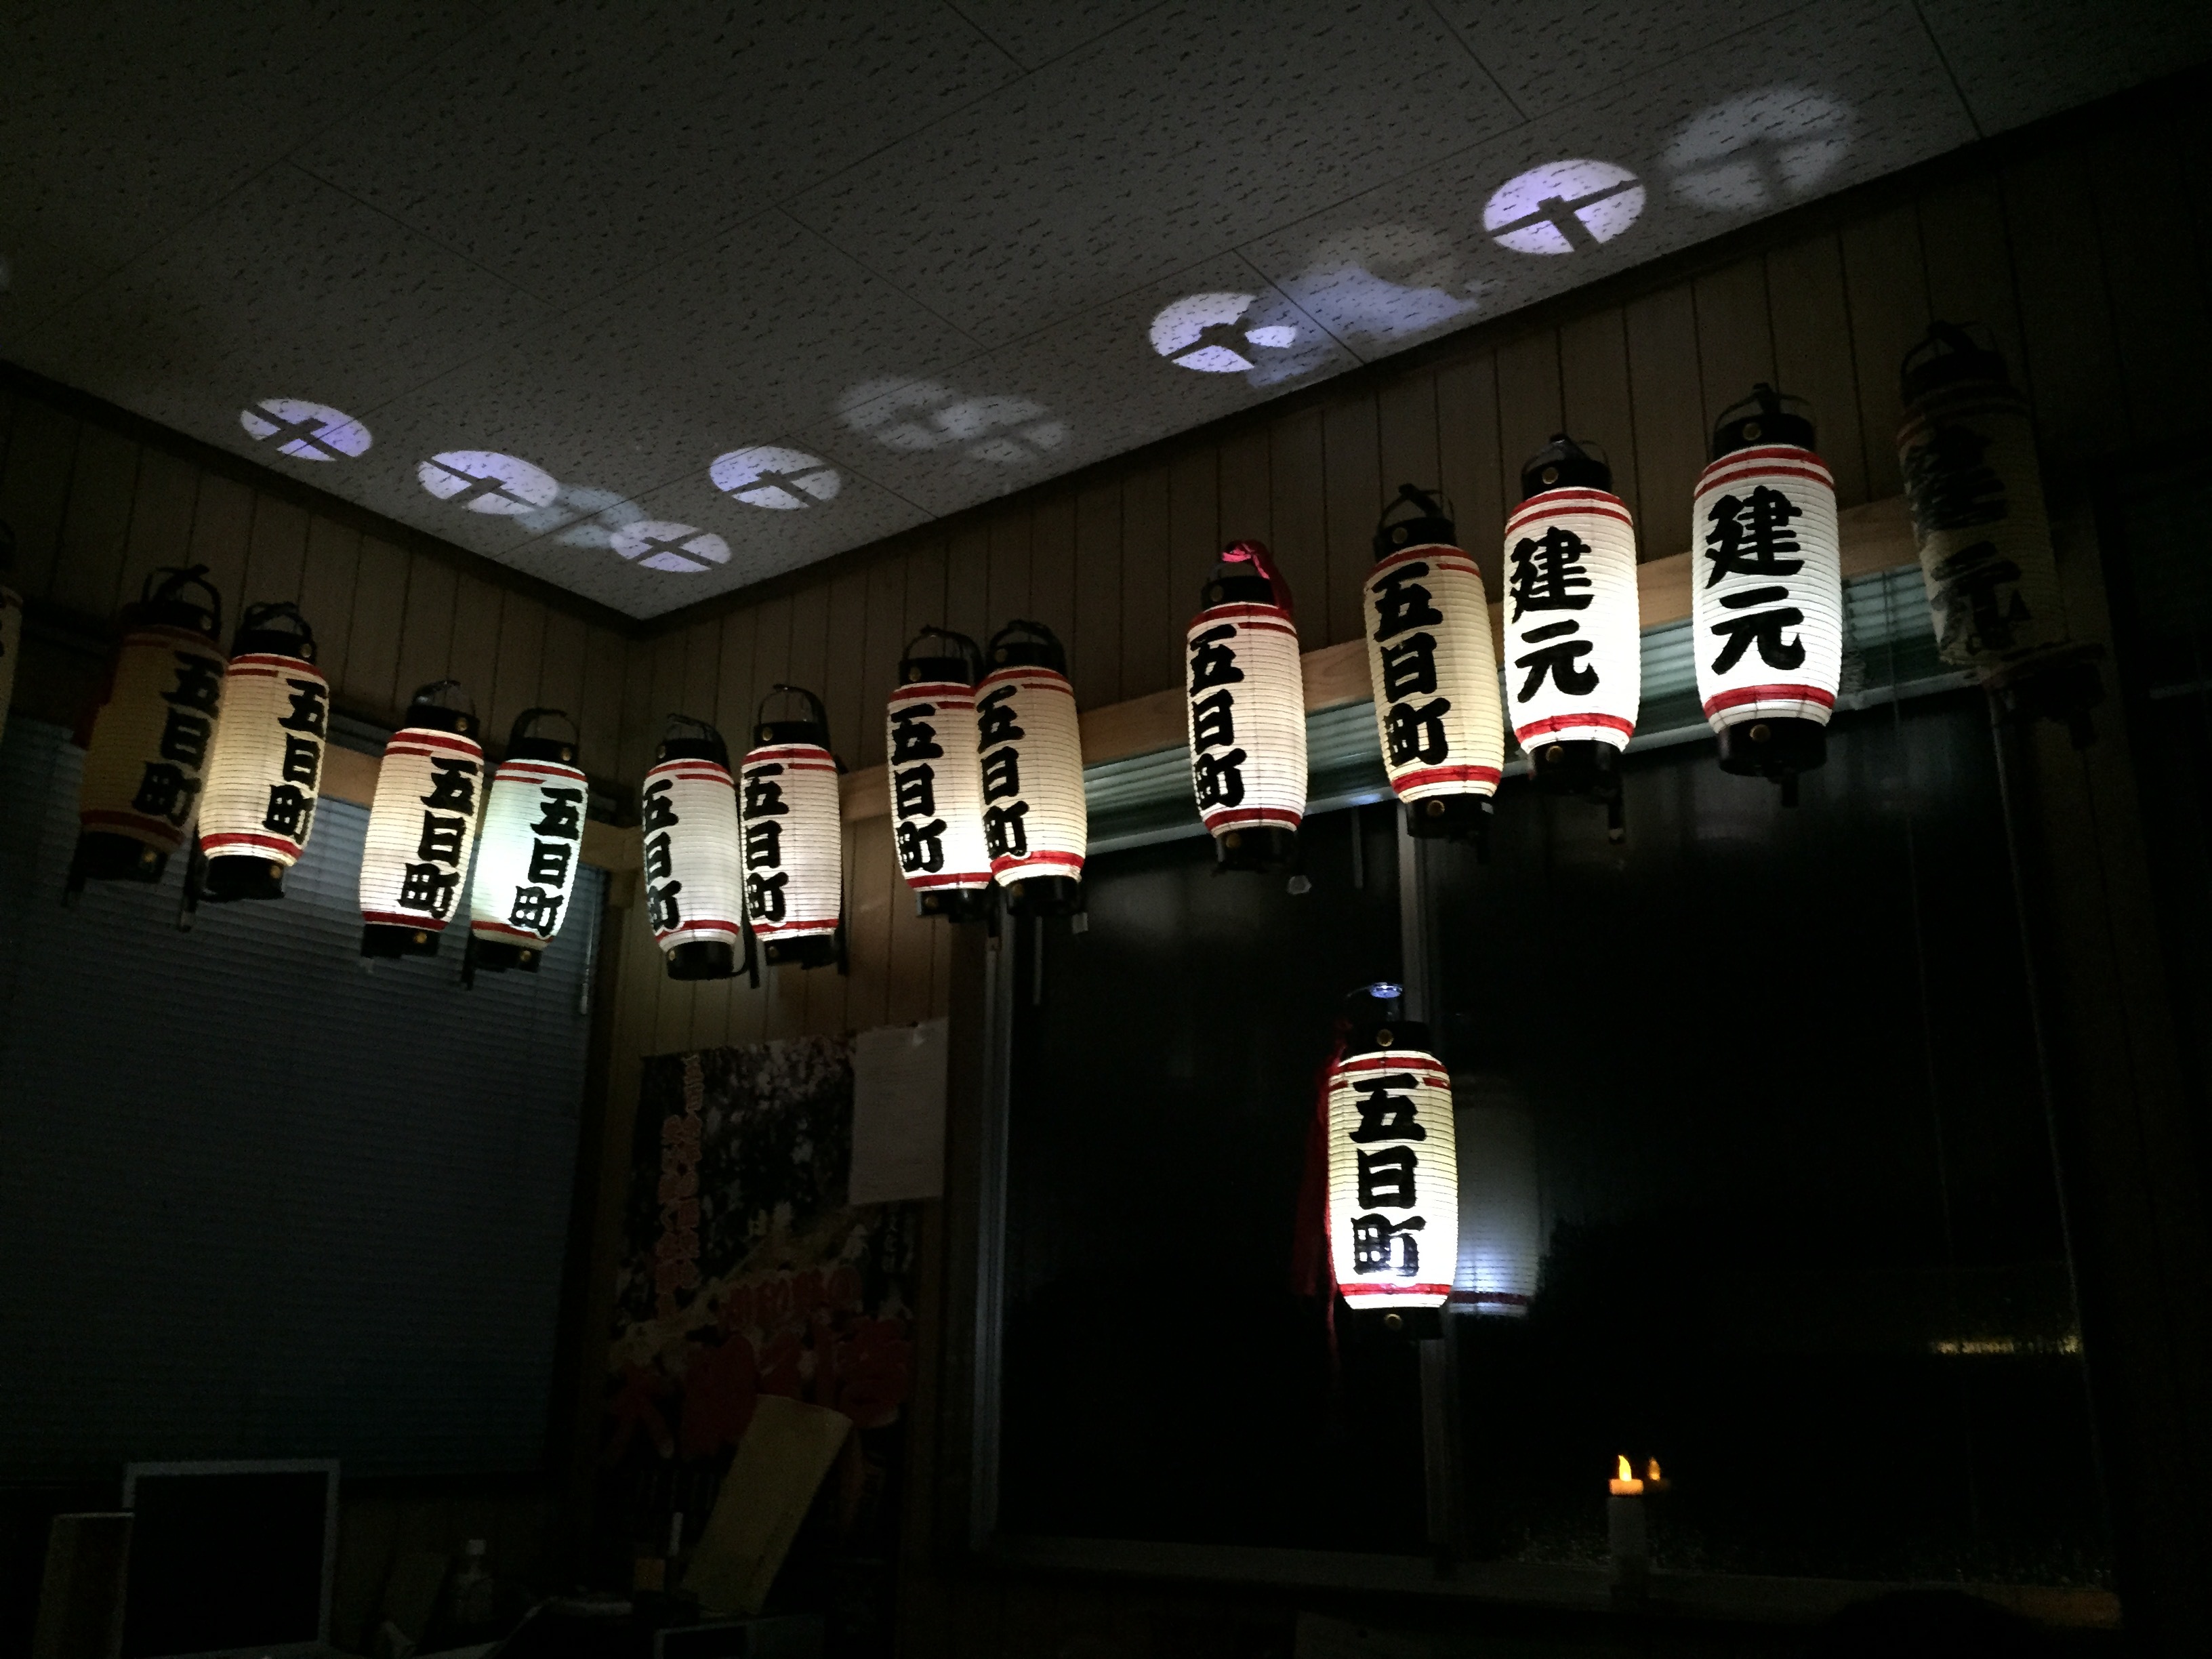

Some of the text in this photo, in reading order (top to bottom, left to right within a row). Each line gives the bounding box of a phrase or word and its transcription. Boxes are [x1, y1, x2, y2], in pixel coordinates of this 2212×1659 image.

[1372, 561, 1452, 766] 五日町
[1510, 527, 1600, 703] 建元
[1705, 485, 1806, 676] 建元
[131, 650, 225, 827] 五日町
[262, 678, 329, 845] 五日町
[890, 703, 947, 874] 五日町
[976, 684, 1030, 859] 五日町
[1189, 623, 1247, 810] 五日町
[397, 756, 478, 919] 五日町
[509, 786, 583, 937] 五日町
[742, 763, 790, 923] 五日町
[1348, 1072, 1427, 1277] 五日町
